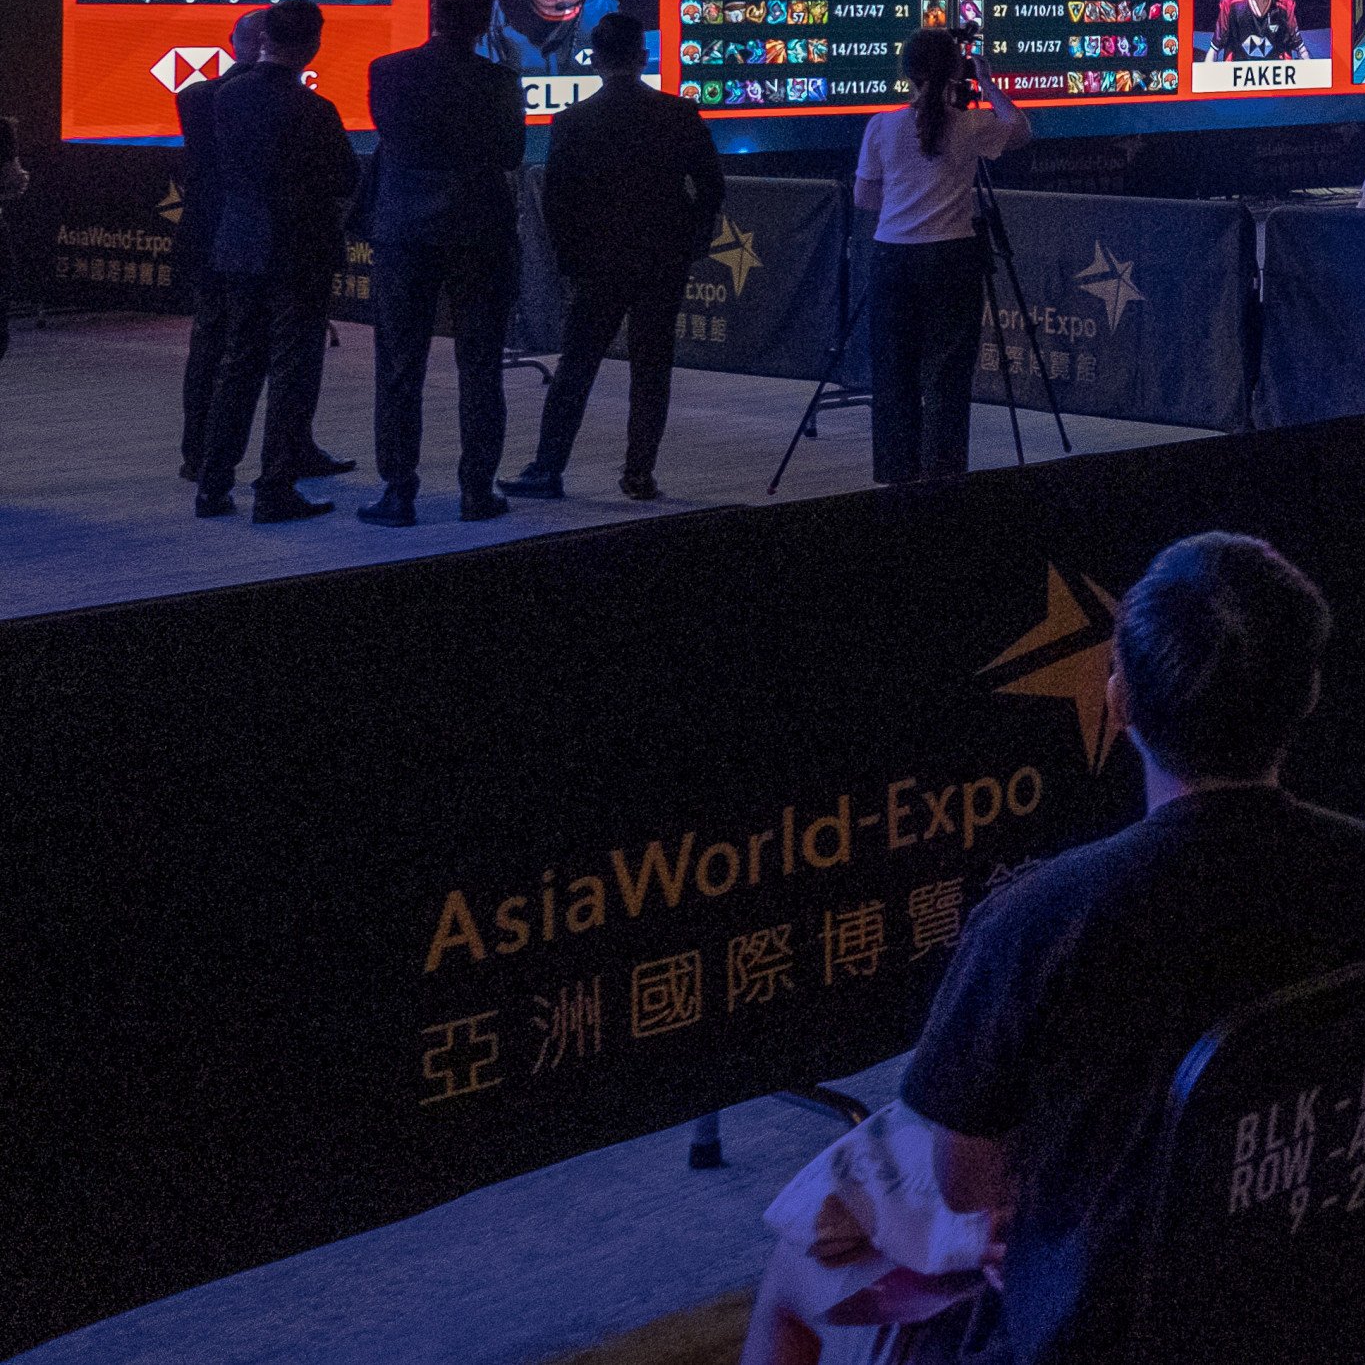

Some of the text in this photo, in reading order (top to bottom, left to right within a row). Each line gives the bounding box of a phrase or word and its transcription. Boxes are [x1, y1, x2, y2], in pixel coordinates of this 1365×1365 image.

[792, 12, 804, 23] 57
[834, 4, 885, 17] 4/13/47
[895, 4, 910, 17] 21
[993, 5, 1008, 17] 27
[1014, 4, 1064, 16] 14/10/18
[831, 42, 888, 56] 14/12/35
[993, 41, 1008, 53] 34
[1017, 40, 1062, 53] 9/15/37
[1014, 76, 1064, 89] 26/12/21
[1232, 65, 1297, 87] FAKER
[830, 80, 910, 95] 14/11/36 42
[525, 83, 581, 110] CLJ
[423, 765, 1044, 975] AsiaWorld-Expo
